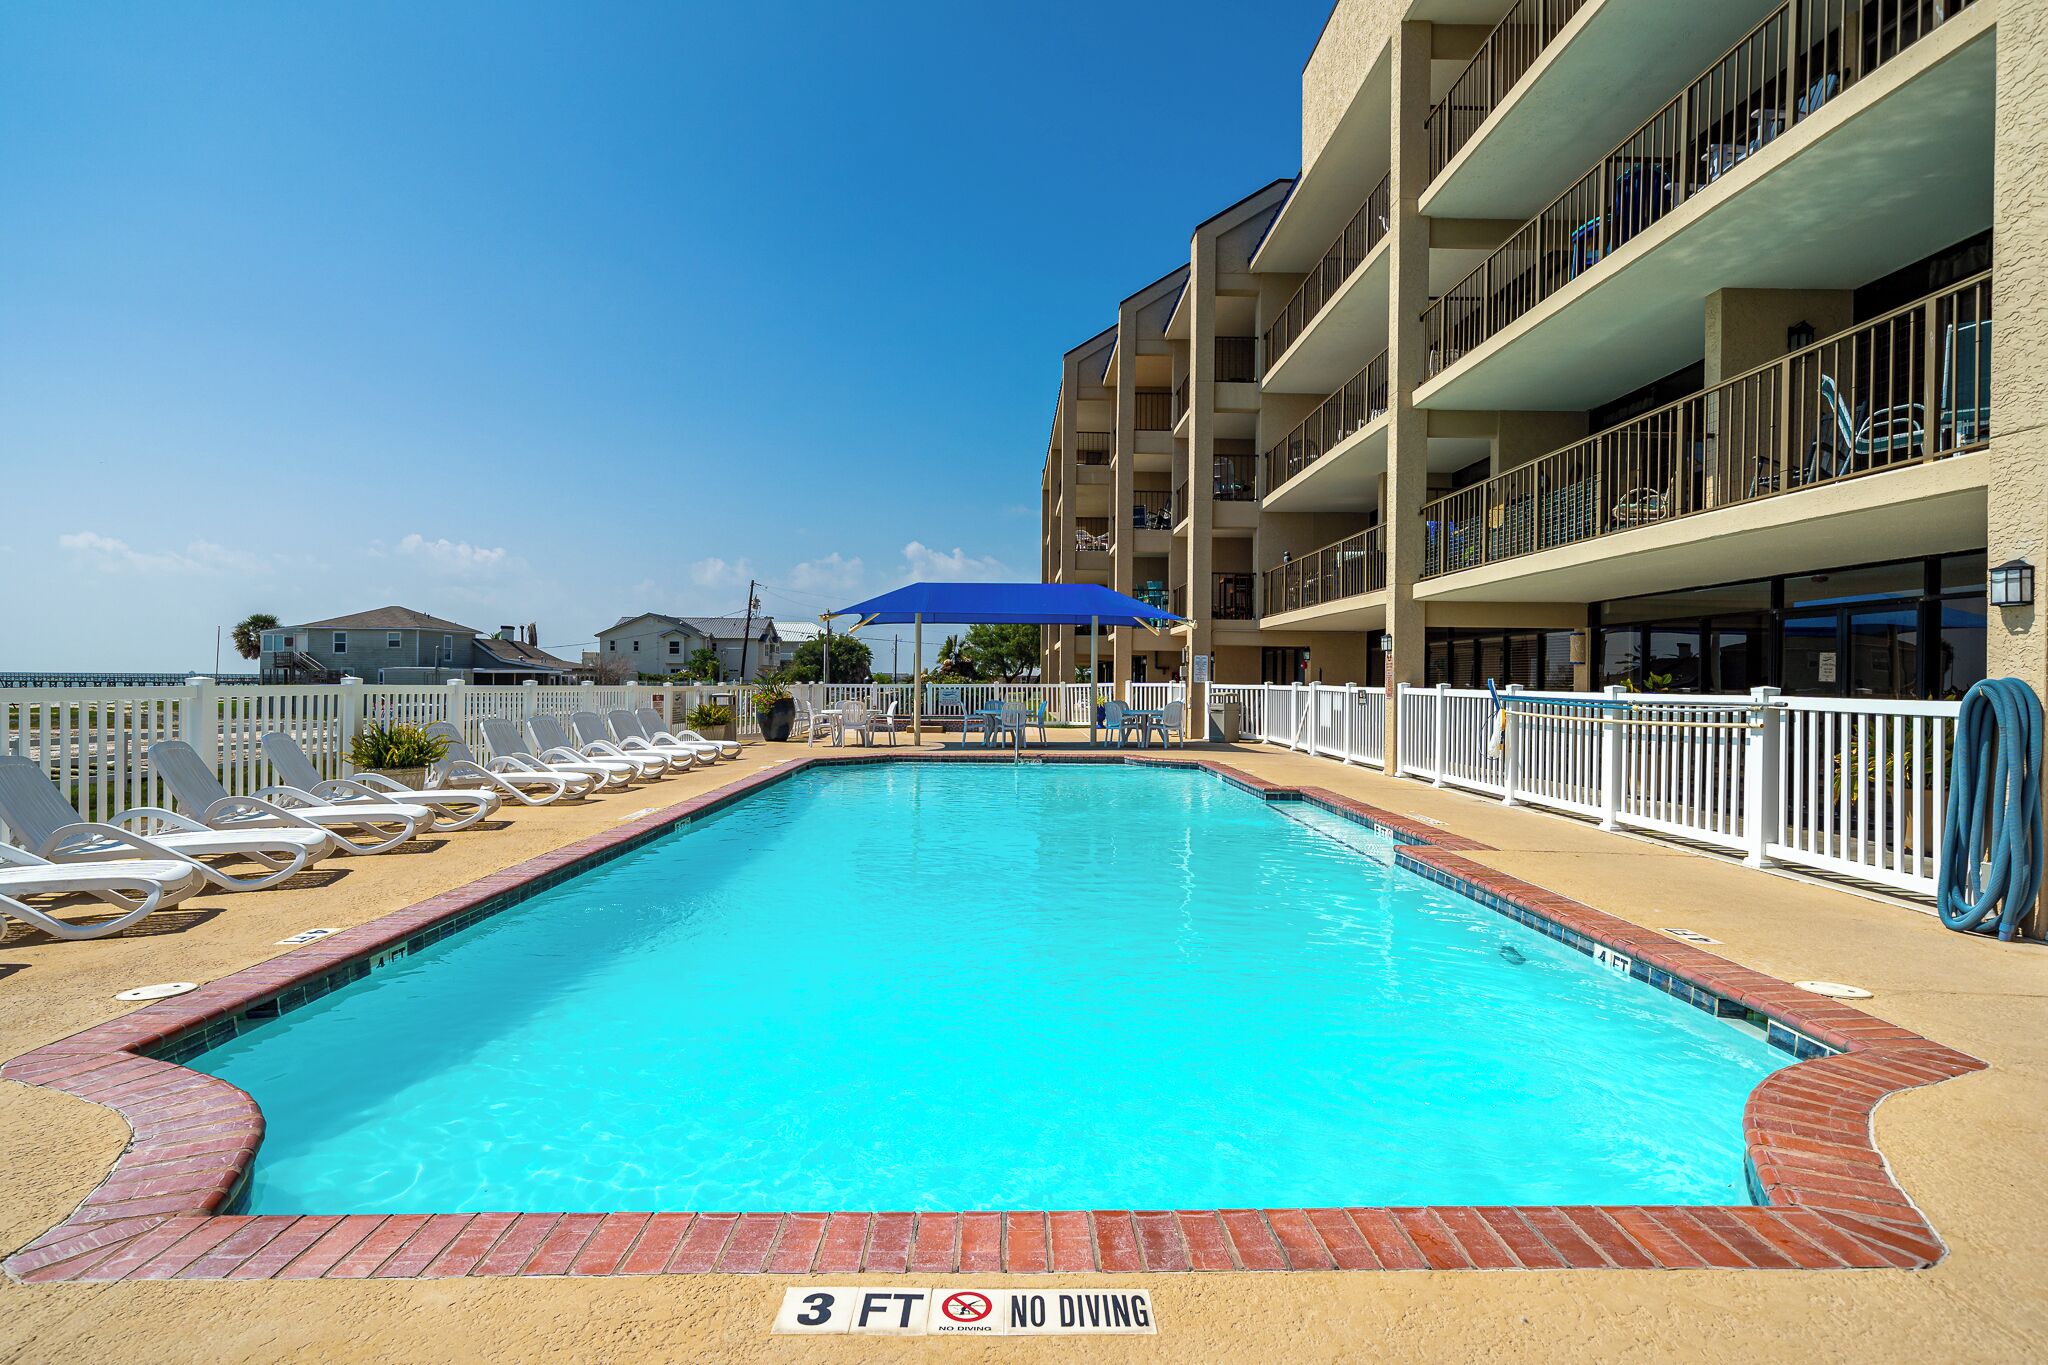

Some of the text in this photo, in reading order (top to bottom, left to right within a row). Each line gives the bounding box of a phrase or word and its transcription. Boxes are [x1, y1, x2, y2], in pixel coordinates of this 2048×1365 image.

[391, 946, 406, 963] FT
[1598, 950, 1629, 972] 4 FT
[796, 1292, 925, 1328] 3 FT
[1010, 1294, 1150, 1328] NO DIVING
